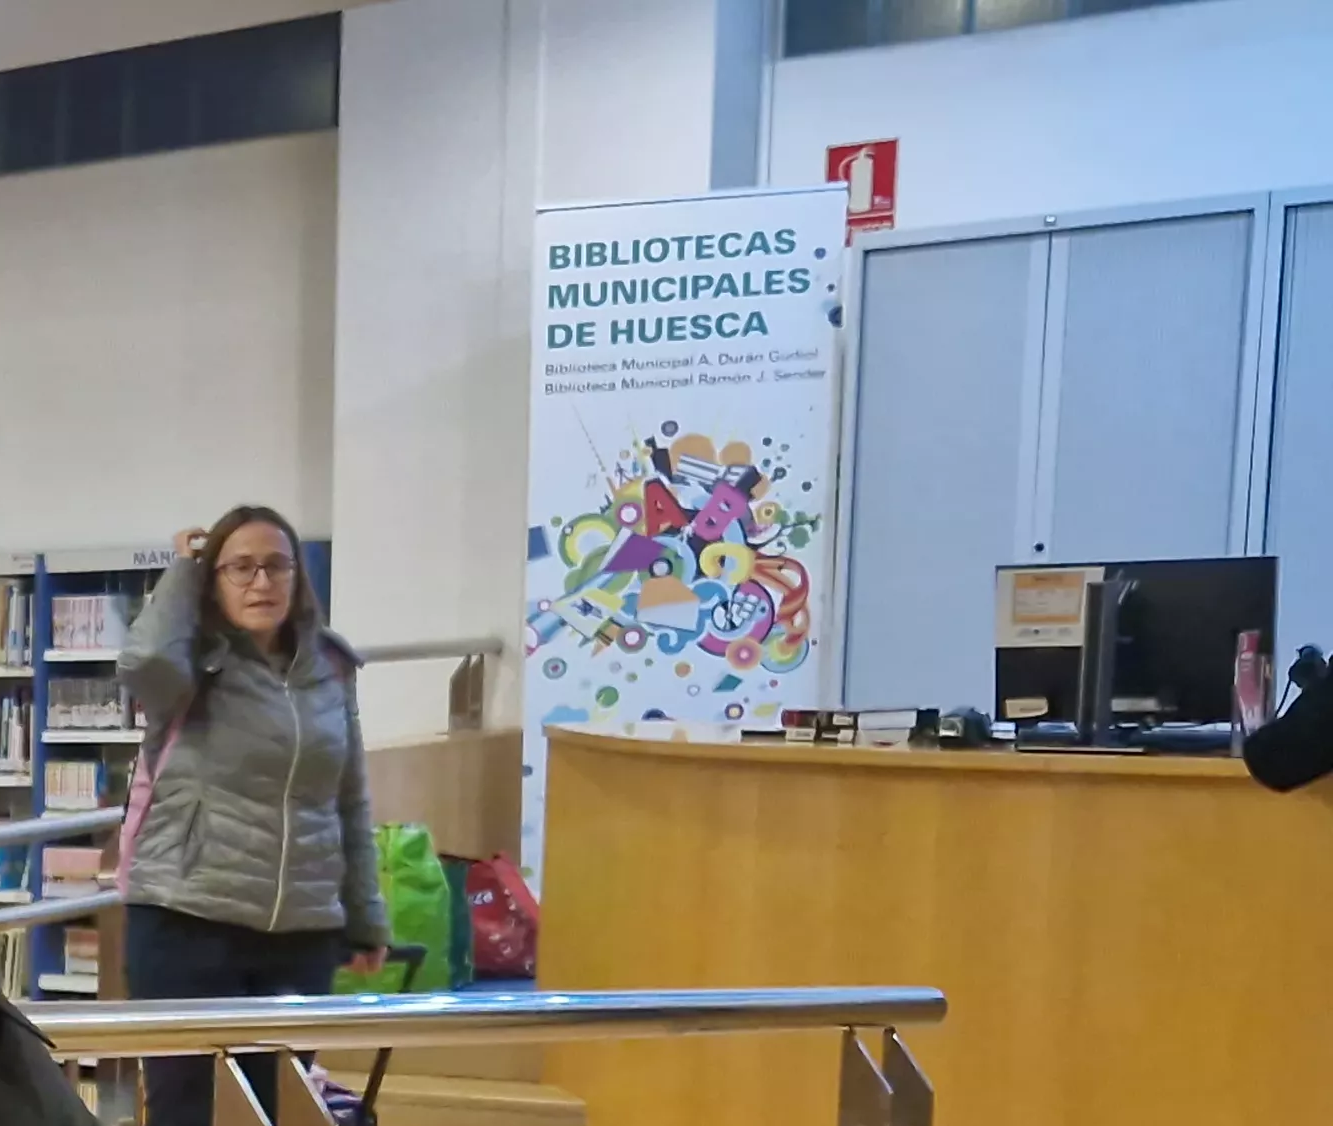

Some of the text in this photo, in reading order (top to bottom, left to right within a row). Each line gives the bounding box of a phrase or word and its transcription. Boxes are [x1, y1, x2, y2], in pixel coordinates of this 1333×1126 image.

[549, 229, 796, 270] BIBLIOTECAS
[548, 268, 811, 309] MUNICIPALES
[547, 310, 769, 349] DE HUESCA
[545, 363, 617, 376] Biblioteca
[621, 355, 693, 371] Municipal
[545, 381, 617, 395] Biblioteca
[621, 375, 693, 390] Municipal
